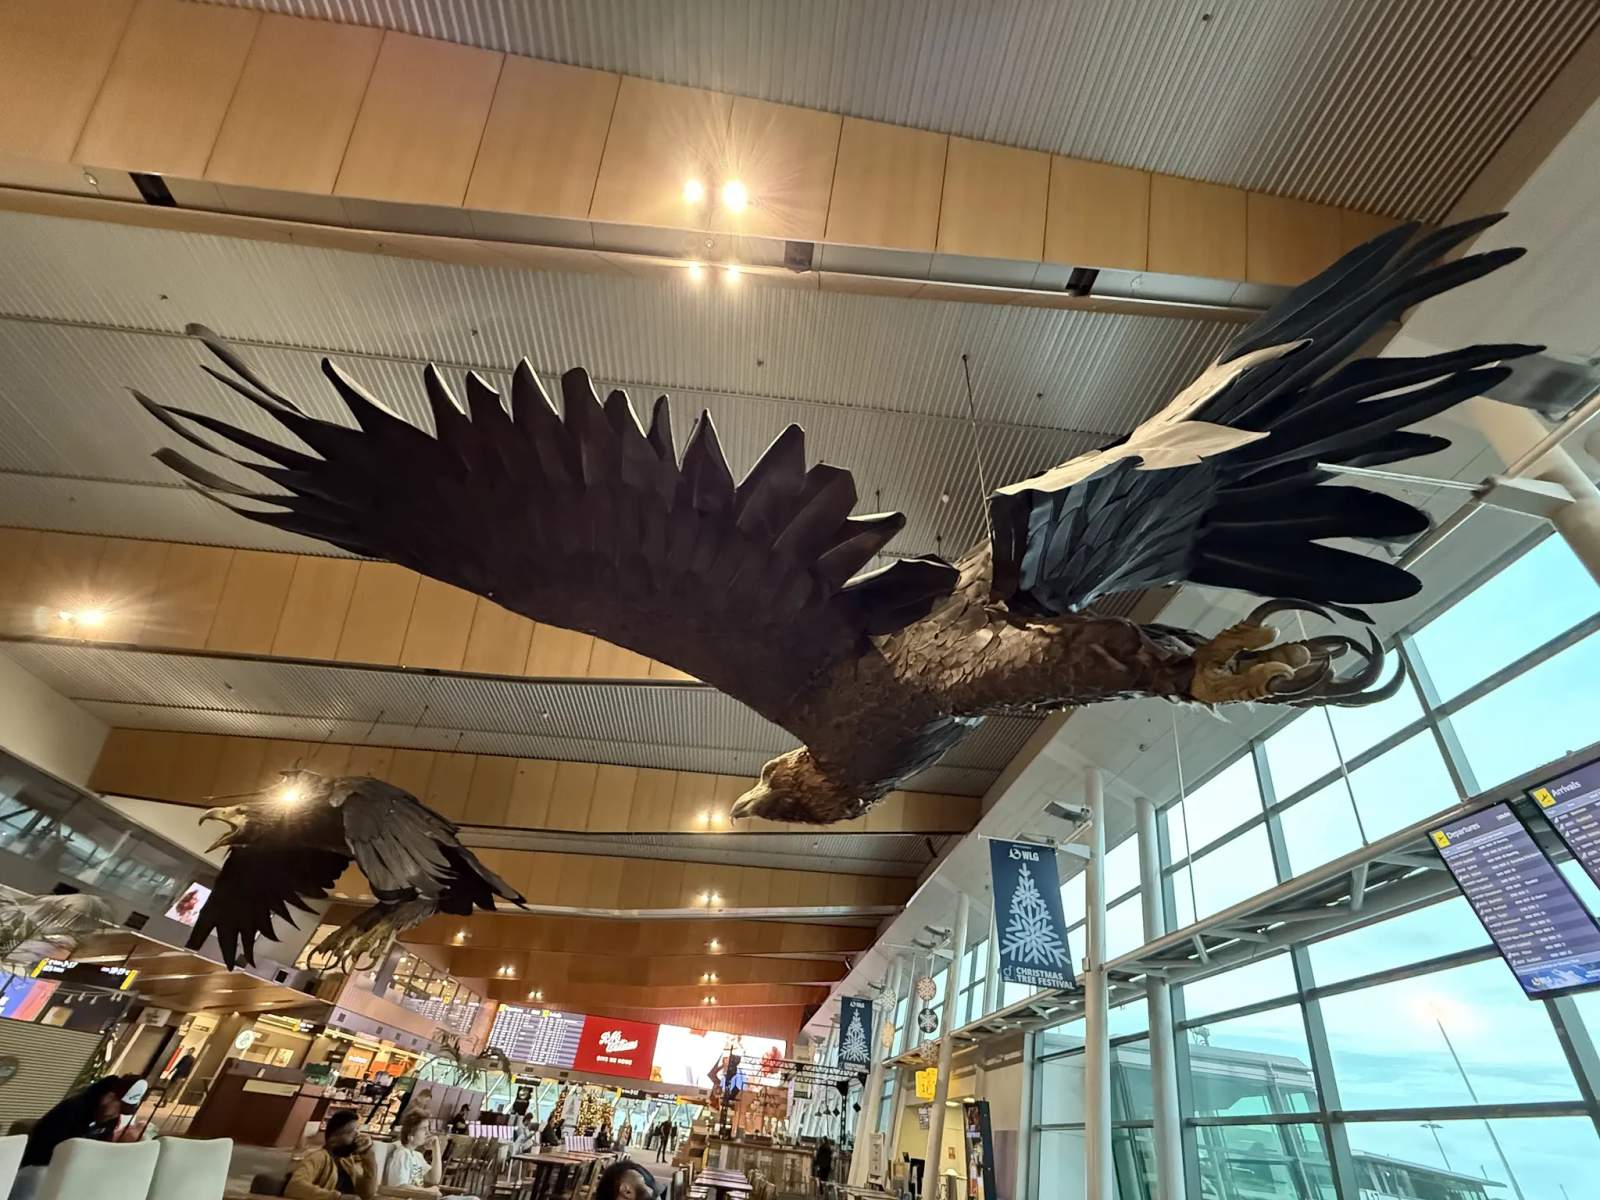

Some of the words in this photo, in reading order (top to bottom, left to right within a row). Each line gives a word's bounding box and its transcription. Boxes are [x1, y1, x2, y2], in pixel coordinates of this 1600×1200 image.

[1551, 781, 1581, 797] Arrivals
[1446, 823, 1480, 839] Departures
[1022, 850, 1039, 861] WLG
[1016, 967, 1063, 980] CHRISTMAS
[1017, 974, 1037, 984] TREE
[1038, 977, 1075, 989] FESTIVAL
